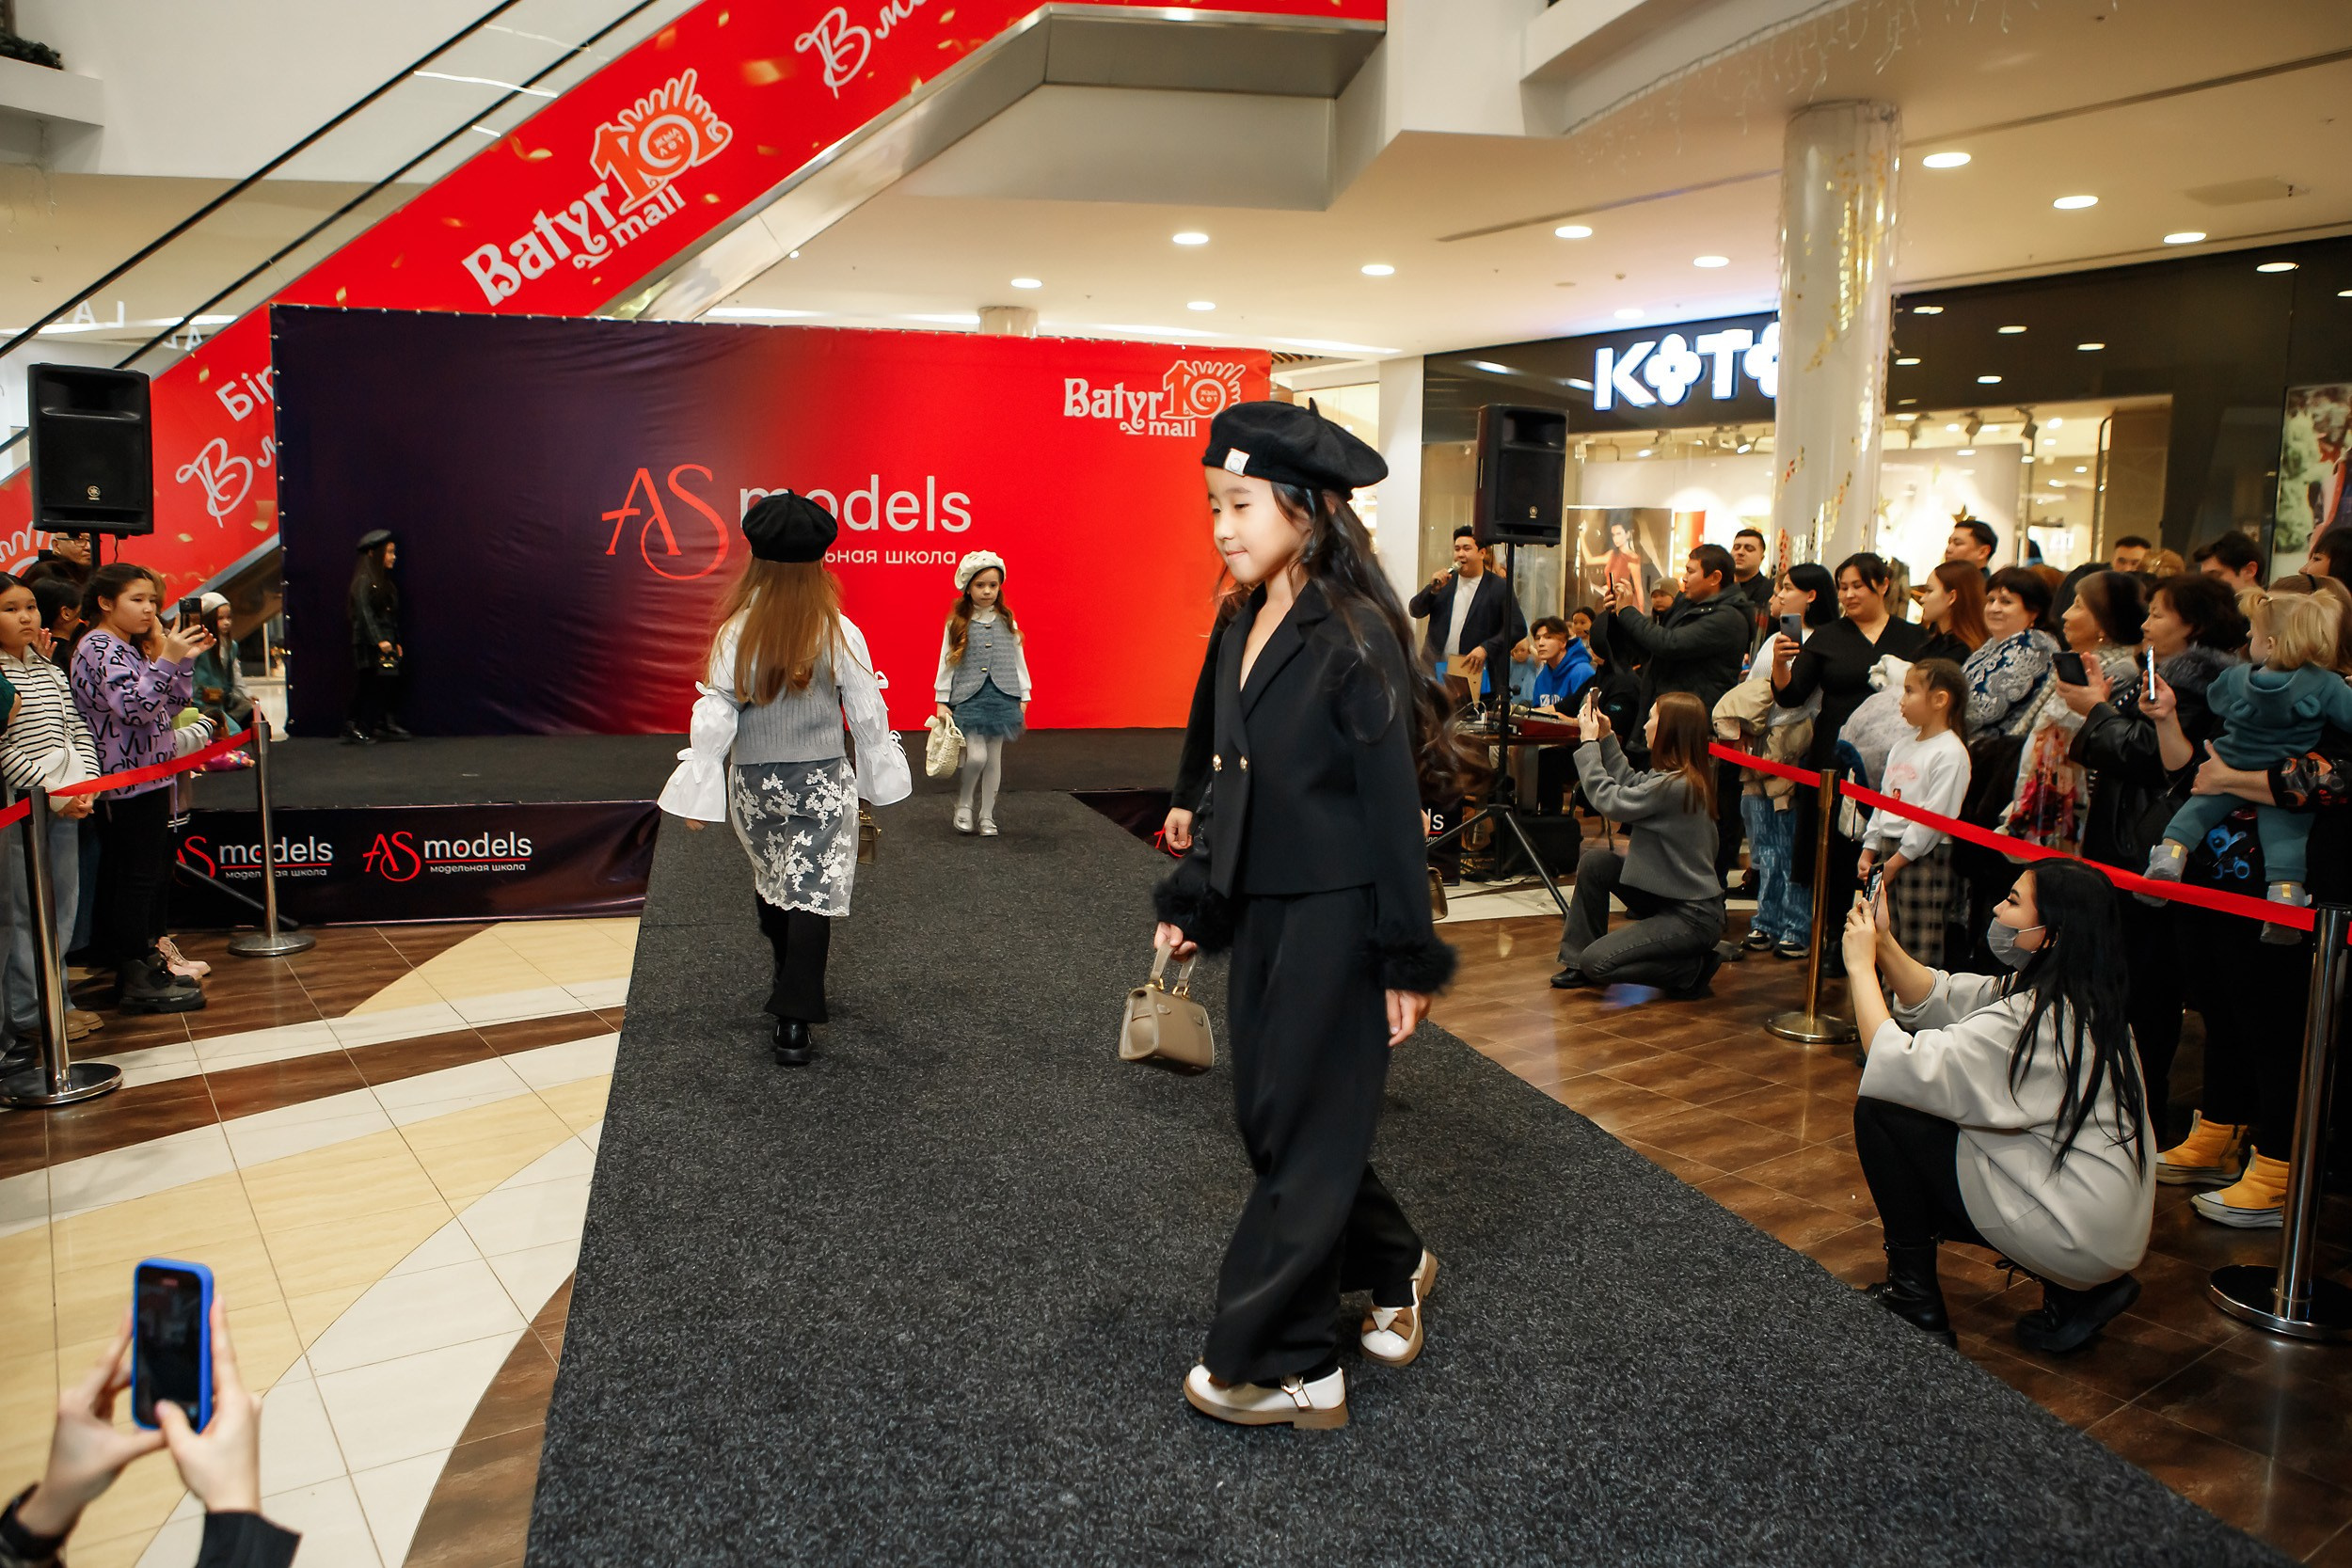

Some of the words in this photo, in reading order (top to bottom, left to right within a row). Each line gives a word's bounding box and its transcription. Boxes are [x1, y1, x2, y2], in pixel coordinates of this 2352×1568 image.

[609, 183, 687, 248] mall
[461, 182, 617, 308] Batyr
[1063, 377, 1165, 436] Batyr
[1148, 420, 1197, 437] mall
[601, 463, 729, 580] AS
[885, 550, 957, 564] школа
[225, 869, 289, 880] моделая
[291, 868, 327, 878] школа
[362, 831, 421, 882] AS
[423, 831, 533, 860] models
[430, 864, 489, 875] модельная
[491, 863, 526, 873] школа
